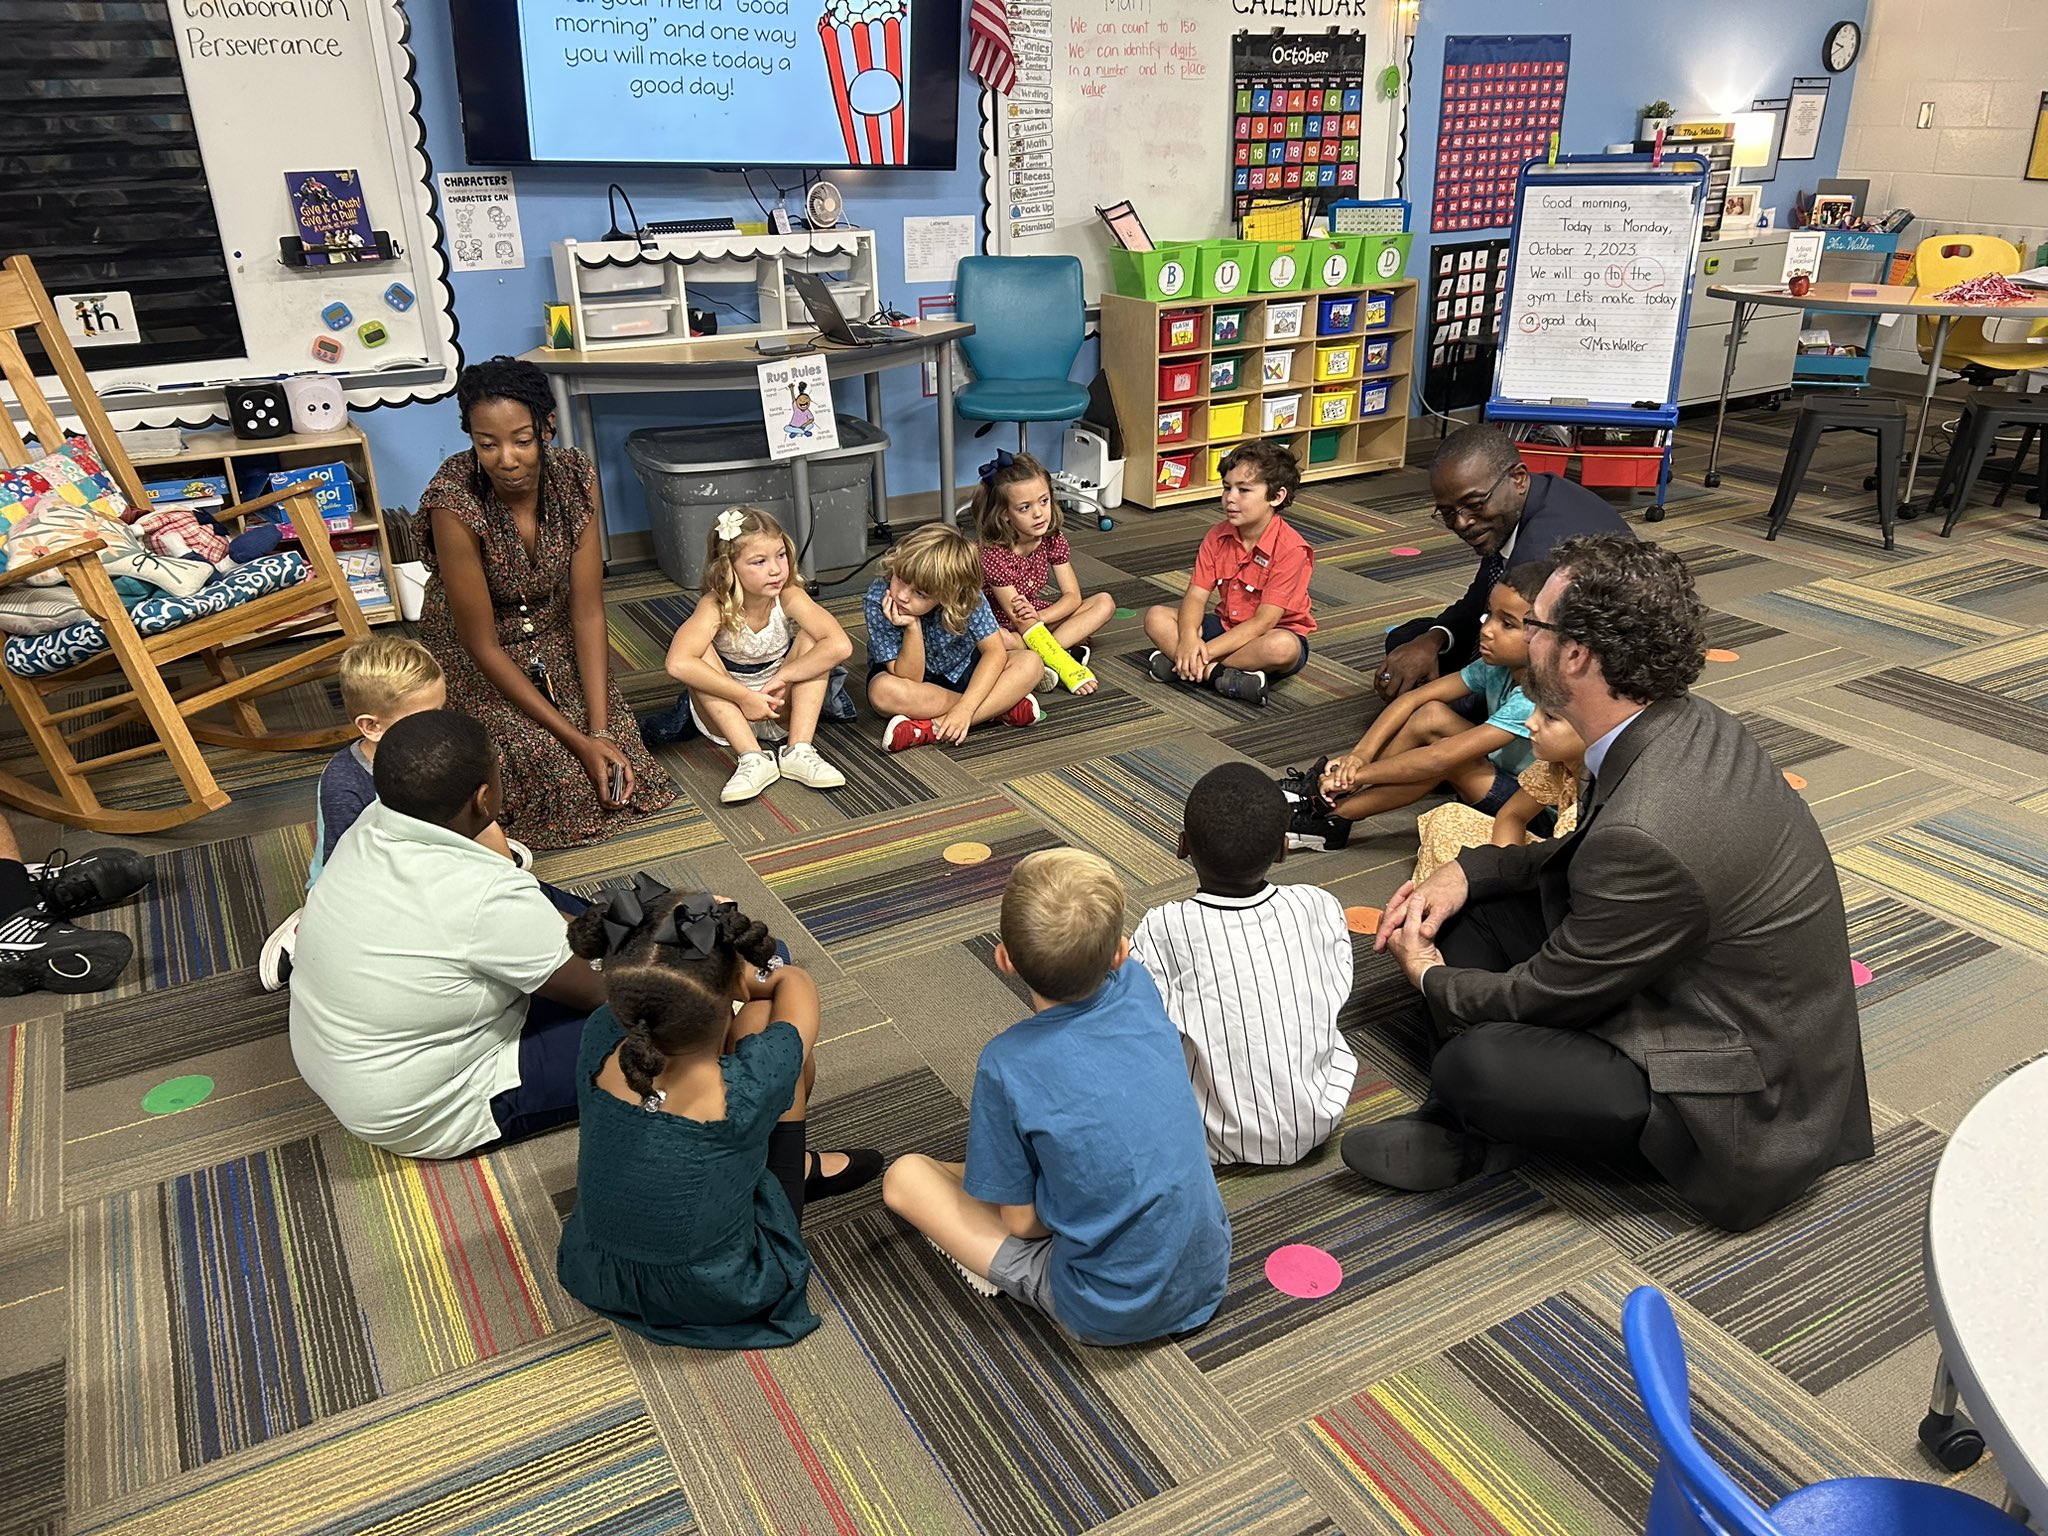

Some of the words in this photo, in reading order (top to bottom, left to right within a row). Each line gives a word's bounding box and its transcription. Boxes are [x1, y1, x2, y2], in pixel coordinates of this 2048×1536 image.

[1022, 8, 1050, 18] Reading
[1070, 16, 1087, 34] We
[1097, 23, 1116, 34] can
[1122, 20, 1150, 34] count
[1158, 19, 1168, 33] to
[1180, 20, 1196, 33] 150
[186, 28, 343, 58] Perseverance
[663, 20, 705, 39] and
[710, 25, 750, 42] one
[753, 28, 797, 49] way
[1069, 43, 1085, 58] We
[1097, 46, 1119, 58] can
[1123, 41, 1160, 59] identify
[1170, 41, 1198, 60] digits
[1272, 46, 1329, 65] October
[564, 47, 608, 67] you
[613, 45, 644, 65] will
[649, 47, 707, 67] make
[712, 50, 773, 76] today
[778, 57, 791, 71] a
[1083, 66, 1091, 77] a
[1096, 64, 1128, 77] number
[1139, 62, 1157, 75] and
[1164, 62, 1175, 75] its
[1180, 62, 1206, 79] place
[629, 76, 684, 99] good
[689, 76, 735, 101] day!
[1080, 80, 1107, 96] value
[1242, 96, 1246, 108] 1
[1258, 96, 1265, 107] 2
[1276, 96, 1283, 107] 3
[1293, 96, 1300, 107] 4
[1312, 96, 1319, 107] 5
[1329, 95, 1337, 106] 6
[1349, 95, 1356, 106] 7
[1240, 123, 1247, 134] 8
[1257, 123, 1264, 134] 9
[1273, 122, 1283, 133] 10
[1290, 122, 1299, 133] 11
[1309, 121, 1318, 132] 12
[1326, 121, 1336, 132] 13
[1346, 120, 1356, 131] 14
[1026, 139, 1047, 149] Math
[1239, 149, 1247, 160] 15
[1253, 149, 1263, 160] 16
[1271, 148, 1282, 159] 17
[1289, 146, 1300, 157] 18
[1307, 146, 1317, 157] 19
[1324, 145, 1336, 156] 20
[1344, 145, 1355, 156] 21
[444, 176, 508, 187] CHARACTERS
[1024, 172, 1051, 181] Recess
[1237, 174, 1247, 185] 22
[1252, 173, 1263, 184] 23
[1268, 172, 1280, 184] 24
[1287, 172, 1299, 183] 25
[1305, 171, 1316, 182] 26
[1321, 170, 1333, 181] 27
[1341, 170, 1354, 181] 28
[300, 205, 322, 217] Give
[331, 203, 338, 211] a
[338, 197, 361, 209] Push!
[448, 195, 492, 203] CHARACTERS
[1542, 194, 1572, 209] Good
[1582, 199, 1631, 212] morning,
[1021, 205, 1041, 214] Pack
[1043, 204, 1053, 213] Up
[300, 216, 322, 228] Give
[331, 213, 338, 221] a
[339, 209, 357, 221] Pull!
[1021, 221, 1054, 232] Dismissal
[1559, 217, 1592, 235] Today
[1604, 221, 1611, 232] is
[1623, 219, 1673, 235] Monday,
[1529, 242, 1574, 256] October
[1847, 235, 1875, 251] Walker
[1167, 266, 1177, 285] B
[1221, 266, 1235, 285] U
[1279, 259, 1287, 277] I
[1331, 258, 1340, 277] L
[1384, 251, 1395, 268] D
[1530, 266, 1546, 279] We
[1554, 266, 1572, 279] will
[1583, 271, 1600, 287] go
[1606, 266, 1620, 281] to
[1630, 266, 1652, 281] the
[1601, 292, 1635, 305] make
[1645, 293, 1677, 310] today
[78, 304, 120, 332] th
[1276, 310, 1297, 319] COINS
[1525, 316, 1534, 325] a
[1541, 314, 1565, 331] good
[1575, 313, 1597, 332] day
[766, 371, 789, 384] Rug
[791, 365, 822, 379] Rules
[1328, 400, 1344, 408] DICE
